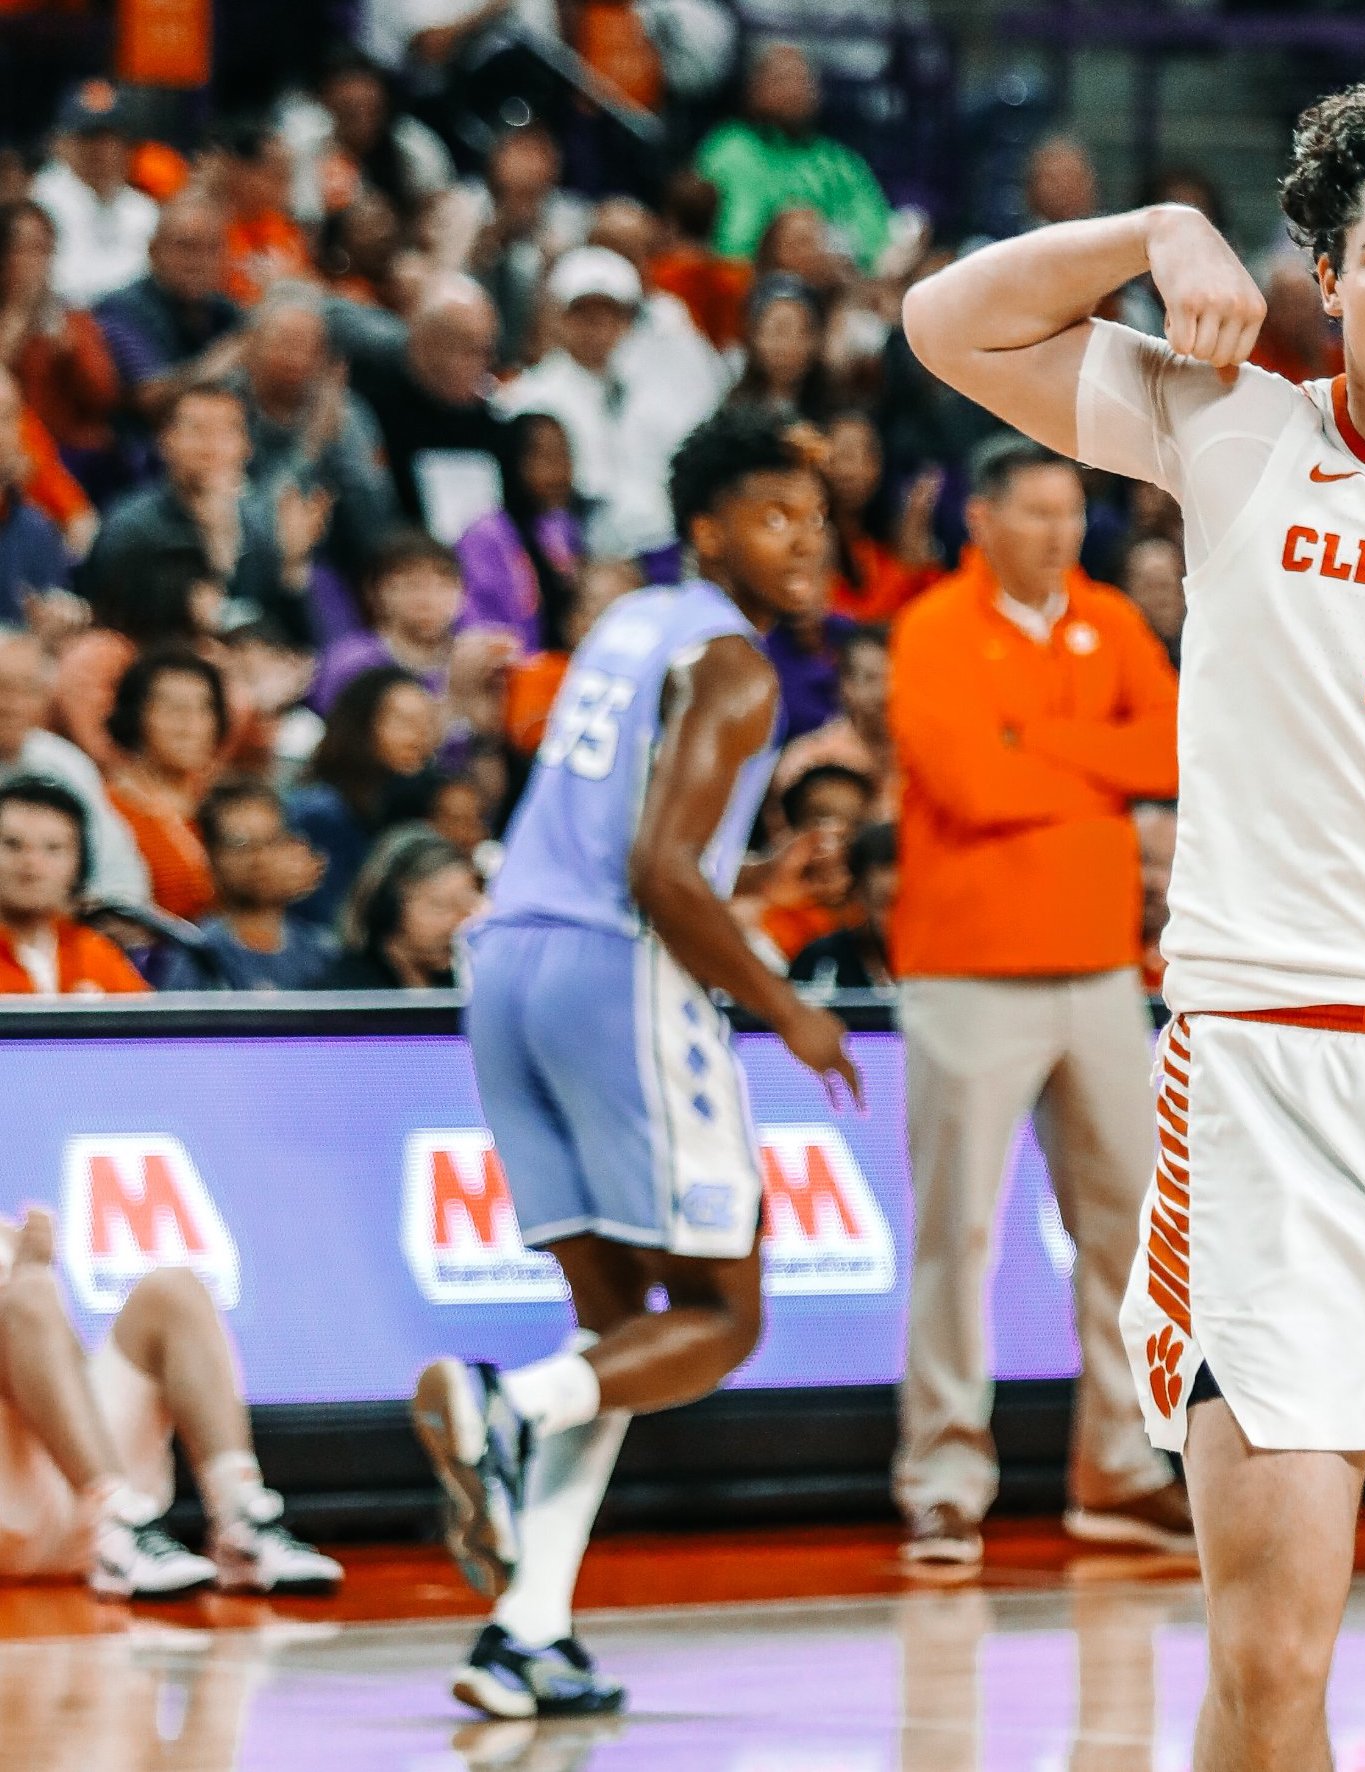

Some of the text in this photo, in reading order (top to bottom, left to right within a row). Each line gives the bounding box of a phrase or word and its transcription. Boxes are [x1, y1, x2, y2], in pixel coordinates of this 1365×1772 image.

[538, 668, 638, 782] 55
[88, 1155, 208, 1256] M
[761, 1145, 863, 1240] M
